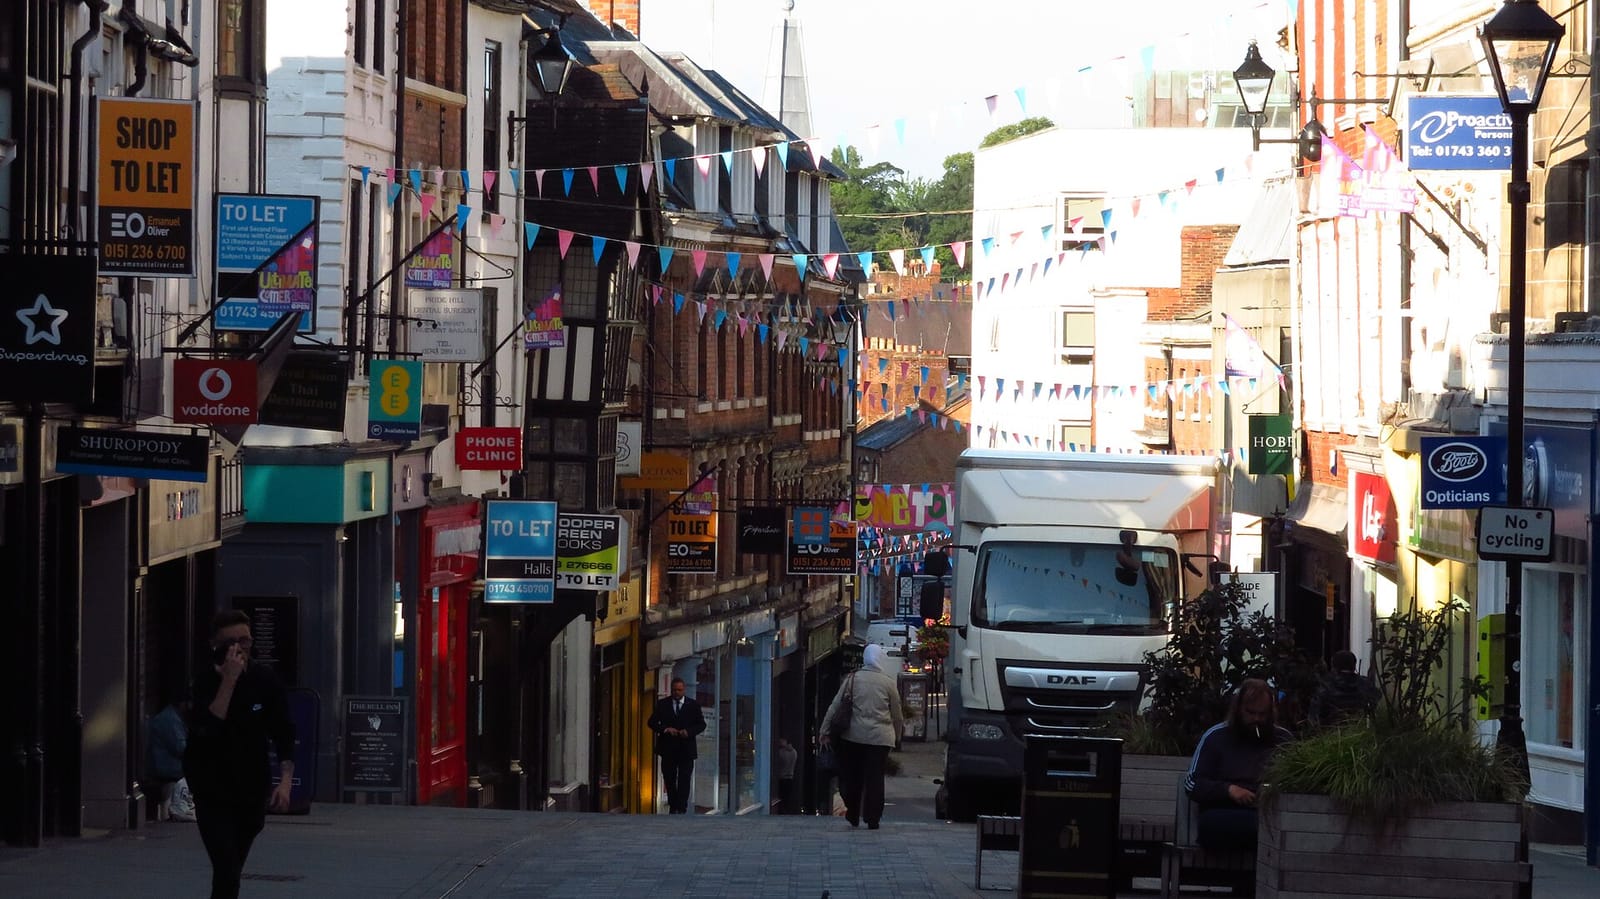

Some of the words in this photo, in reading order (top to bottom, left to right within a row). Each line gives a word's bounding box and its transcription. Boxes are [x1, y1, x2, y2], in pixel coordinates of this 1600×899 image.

[116, 116, 177, 151] SHOP
[1410, 145, 1433, 156] Tel:
[1435, 146, 1474, 156] 01743
[1477, 146, 1501, 157] 360
[111, 159, 140, 193] TO
[146, 161, 182, 194] LET
[222, 204, 247, 221] TO
[252, 206, 287, 222] LET
[111, 212, 145, 239] EO
[147, 215, 181, 226] Emanuel
[147, 226, 170, 236] Oliver
[105, 243, 128, 258] 0151
[132, 244, 153, 259] 236
[157, 245, 186, 260] 6700
[220, 306, 257, 317] 01743
[181, 403, 250, 416] vodafone
[80, 435, 182, 455] SHUROPODY
[466, 436, 515, 447] PHONE
[466, 451, 516, 461] CLINIC
[1437, 451, 1479, 473] Boots
[1426, 490, 1490, 504] Opticians
[491, 519, 513, 537] TO
[519, 520, 552, 537] LET
[669, 520, 686, 535] TO
[689, 520, 710, 536] LET
[1505, 514, 1528, 529] No
[1486, 534, 1544, 550] cycling
[793, 557, 810, 566] 0151
[524, 562, 551, 575] Halls
[565, 574, 583, 584] TO
[587, 575, 612, 586] LET
[488, 584, 515, 593] 01743
[517, 584, 549, 593] 450700
[1047, 675, 1097, 685] DAF
